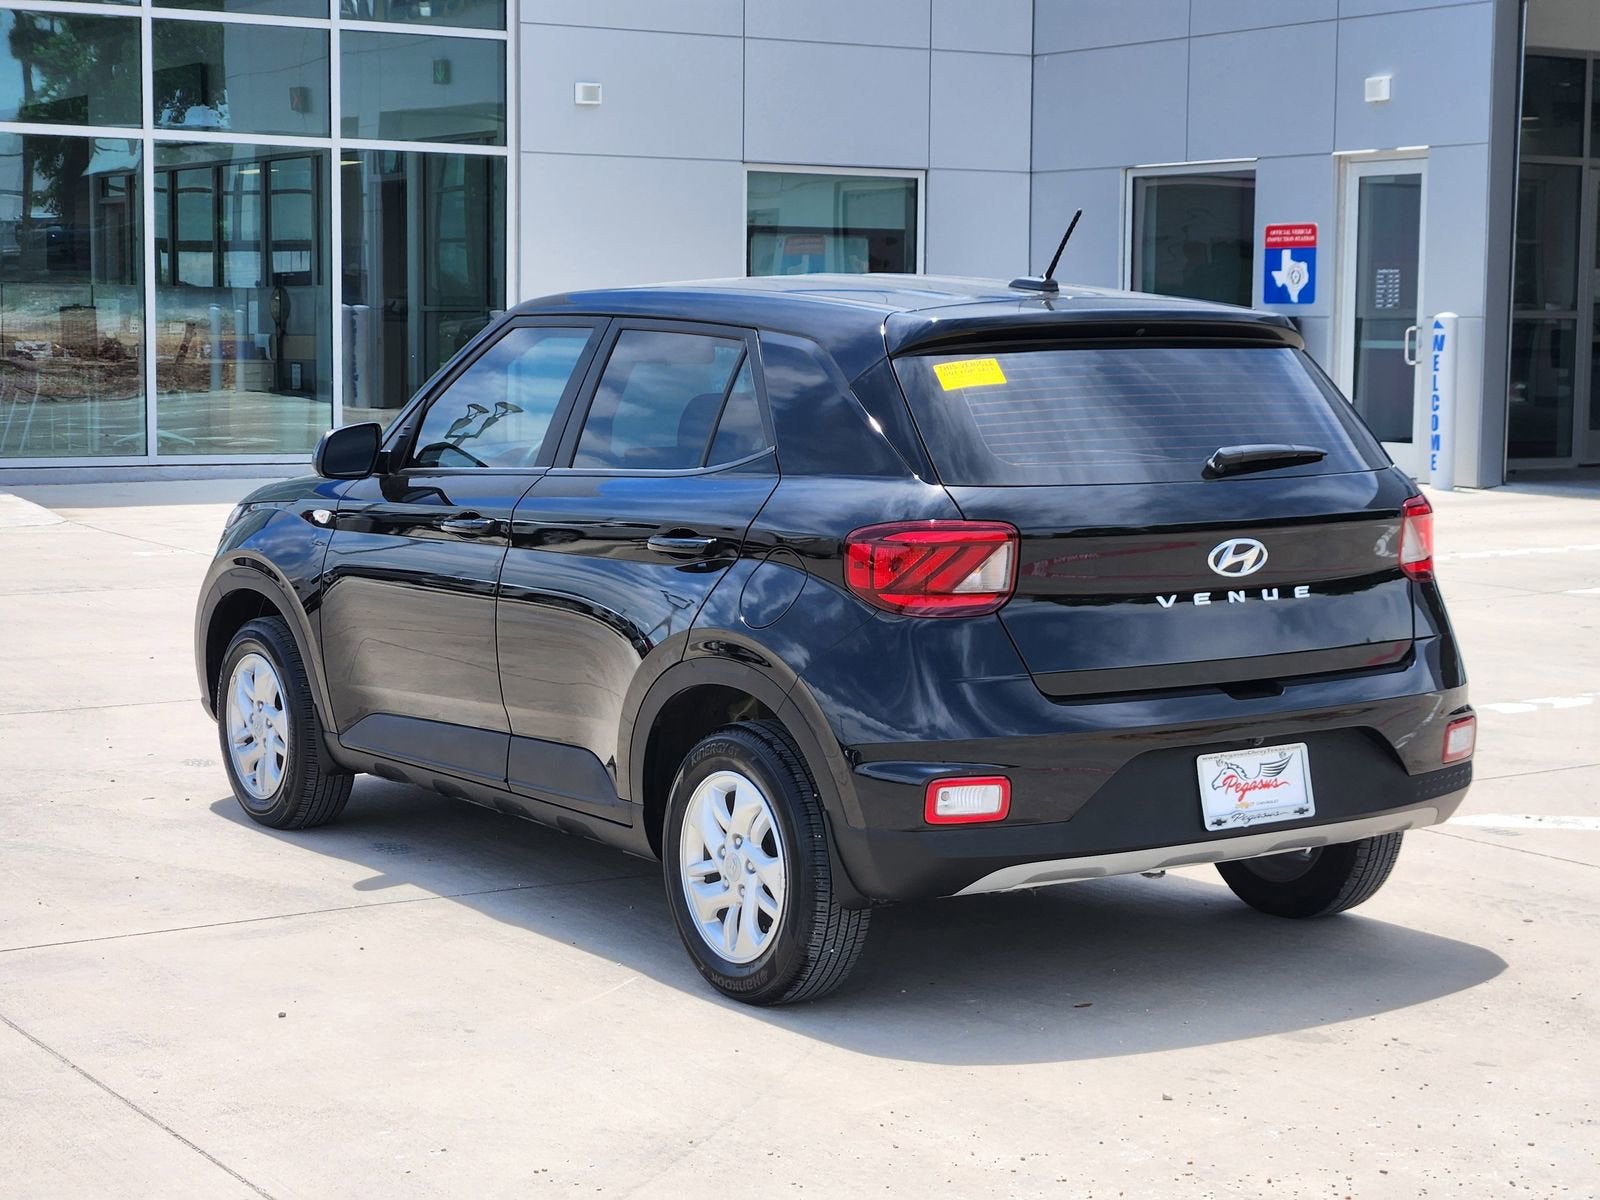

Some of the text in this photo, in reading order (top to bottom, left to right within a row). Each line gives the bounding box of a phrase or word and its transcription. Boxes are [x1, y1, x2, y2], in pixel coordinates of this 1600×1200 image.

[1430, 334, 1446, 471] WELCOME
[1155, 585, 1311, 609] VENUE
[690, 742, 729, 767] KINERGY
[1222, 774, 1289, 802] Pegasus
